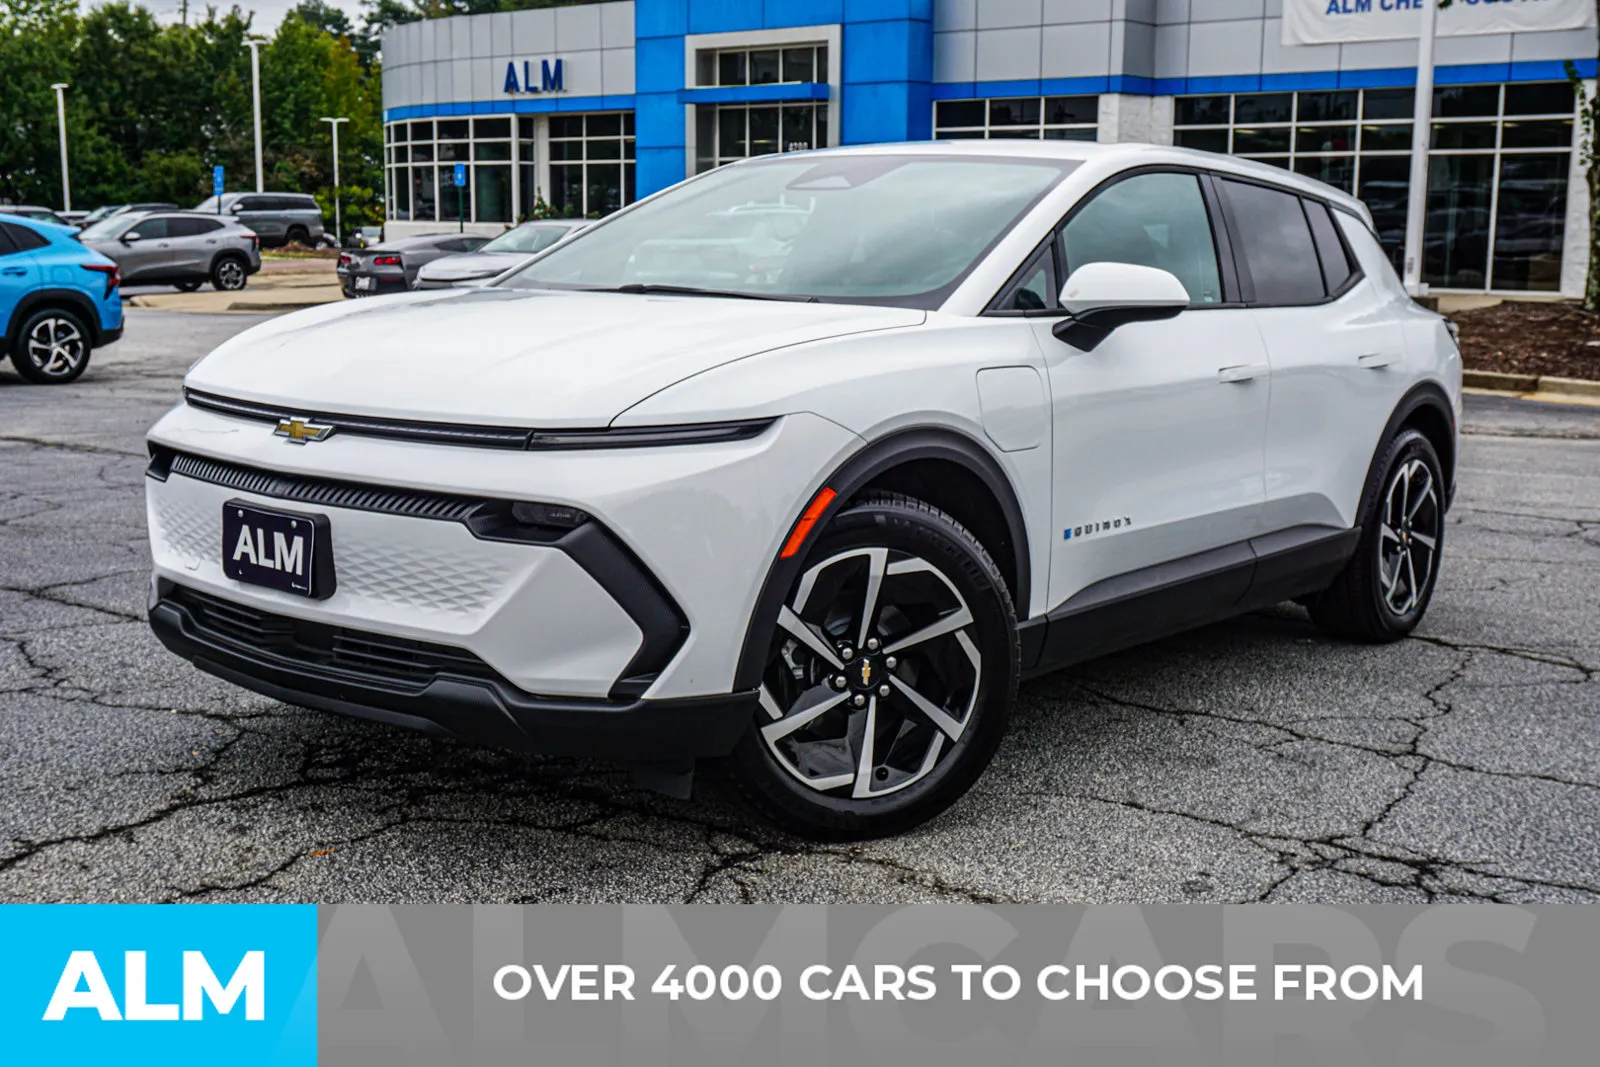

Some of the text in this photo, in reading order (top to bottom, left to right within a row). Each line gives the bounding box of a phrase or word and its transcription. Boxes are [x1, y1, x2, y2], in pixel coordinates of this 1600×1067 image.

[1326, 0, 1425, 15] ALM CHE
[503, 58, 564, 93] ALM
[1063, 515, 1132, 541] EQUINOX
[232, 524, 304, 576] ALM
